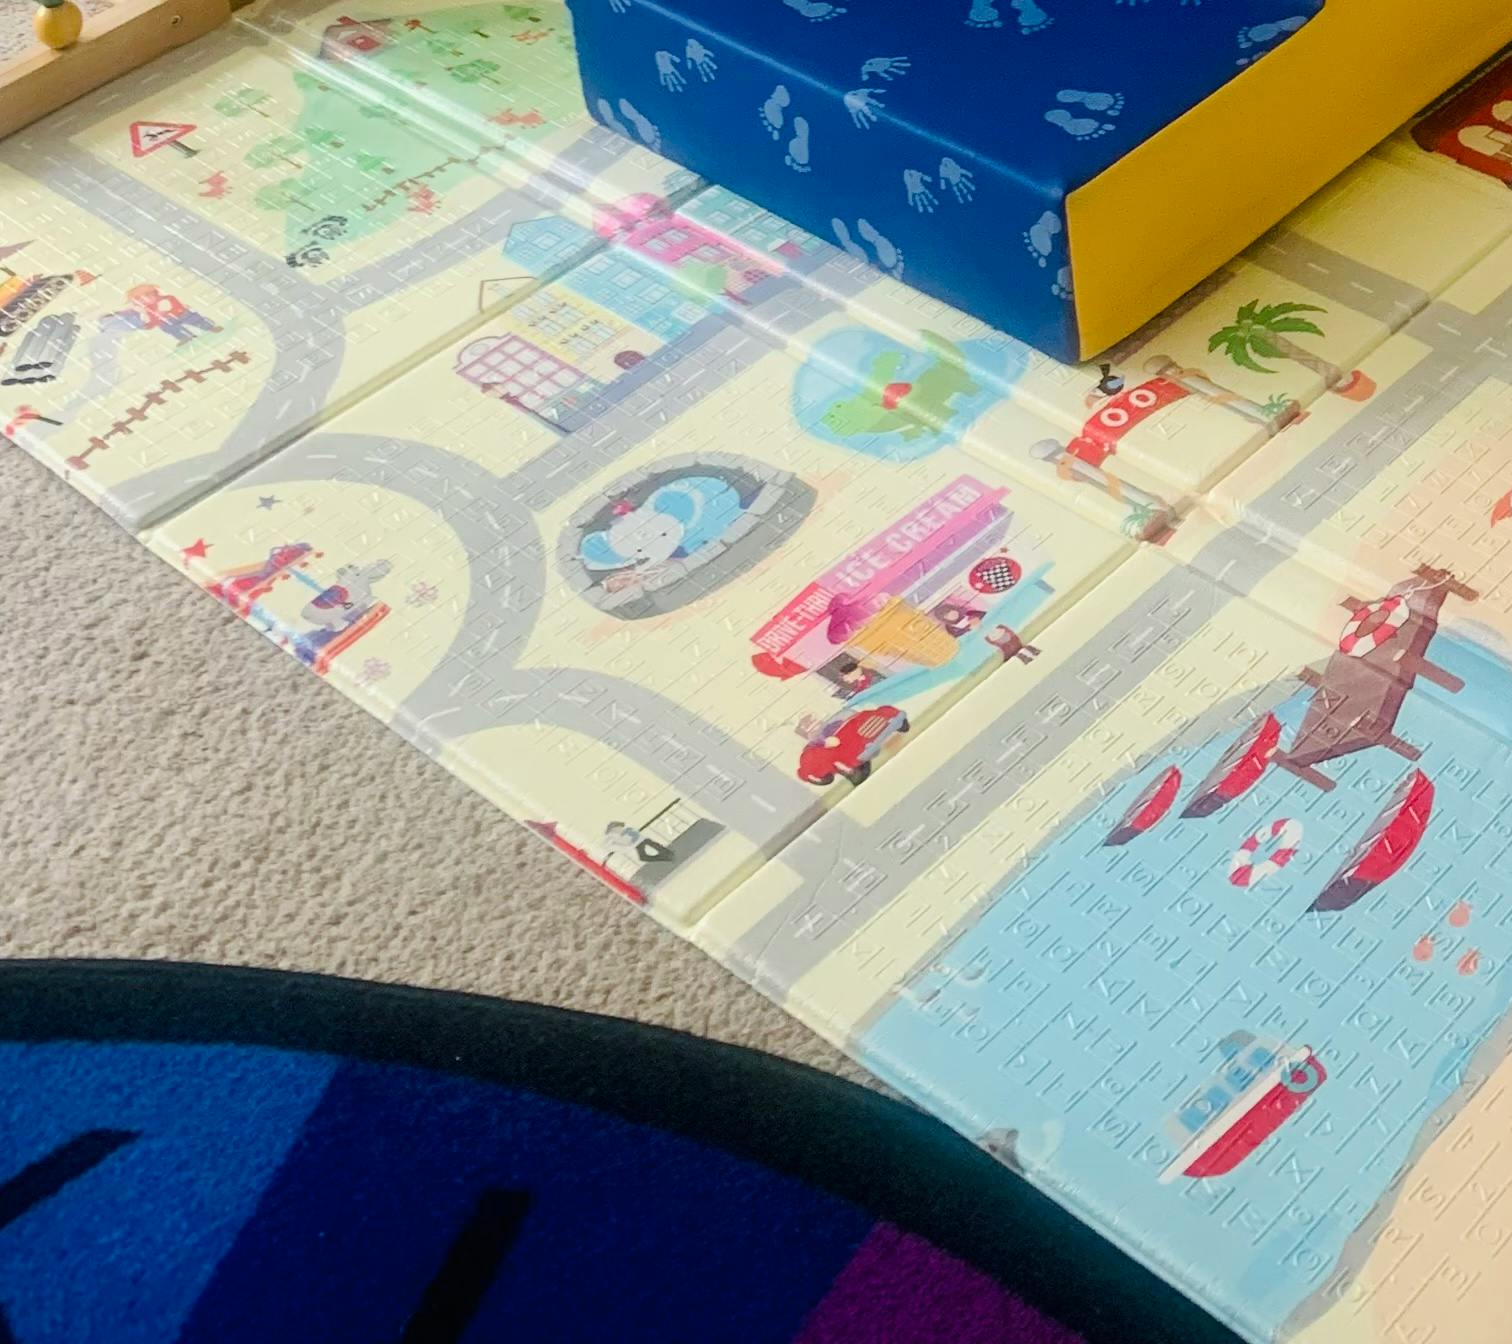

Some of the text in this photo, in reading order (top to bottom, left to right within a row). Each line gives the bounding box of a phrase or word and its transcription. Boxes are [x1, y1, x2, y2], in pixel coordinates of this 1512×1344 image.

[836, 483, 985, 590] ICE CREAM
[756, 587, 836, 654] DRIVE-THRU
